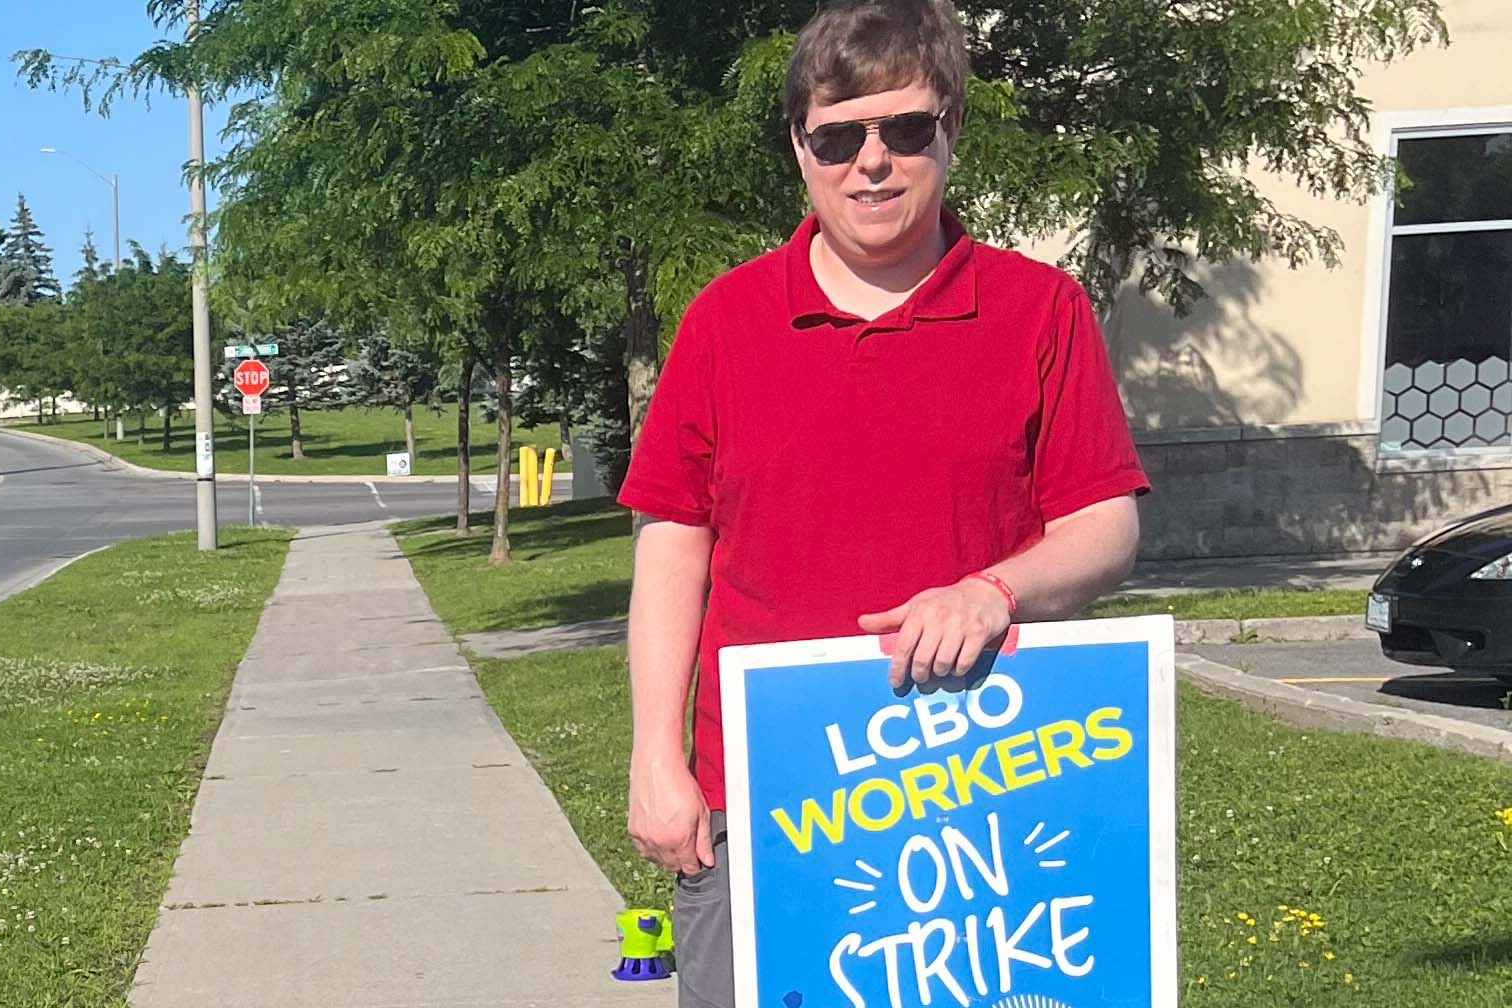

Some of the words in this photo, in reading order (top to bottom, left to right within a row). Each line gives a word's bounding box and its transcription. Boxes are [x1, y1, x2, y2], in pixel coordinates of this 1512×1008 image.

[236, 371, 268, 385] STOP
[825, 672, 1023, 776] LCBO
[770, 706, 1133, 854] WORKERS
[898, 812, 1009, 913] ON
